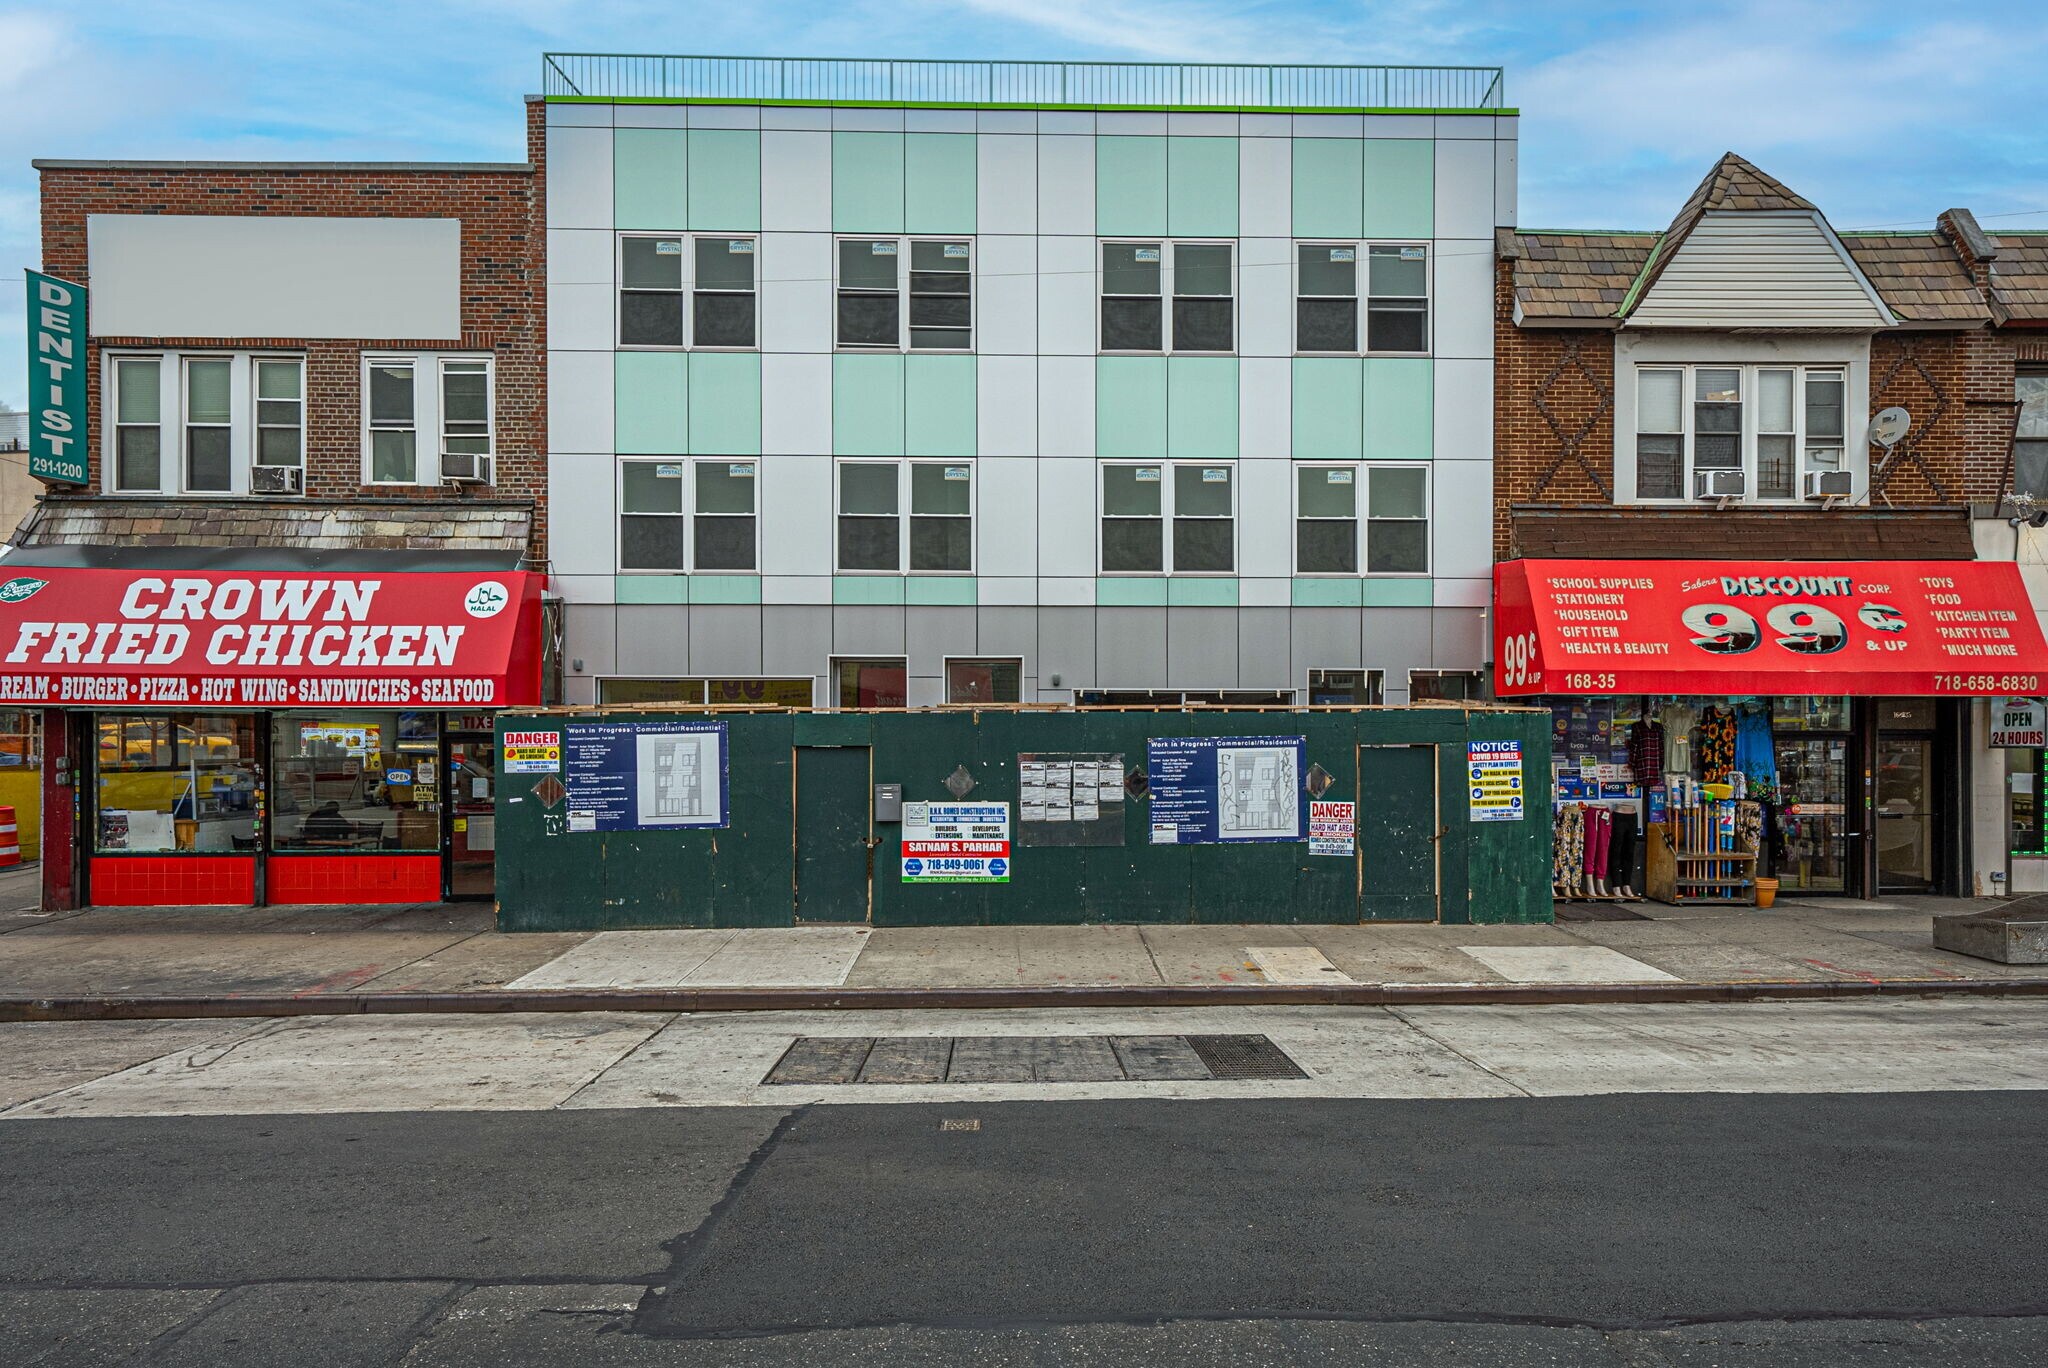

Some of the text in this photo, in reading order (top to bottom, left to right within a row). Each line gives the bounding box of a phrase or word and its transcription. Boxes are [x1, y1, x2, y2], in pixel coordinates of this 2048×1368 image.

[38, 280, 73, 456] DENTIST
[33, 456, 82, 478] 291-1200
[1552, 578, 1654, 589] SCHOOL SUPPLIES
[1682, 576, 1892, 597] Sabera DISCOUNT CORP.
[1926, 578, 1954, 588] TOYS
[119, 578, 382, 621] CROWN
[1556, 594, 1624, 604] STATIONERY
[1930, 594, 1961, 605] FOOD
[1560, 610, 1628, 620] HOUSEHOLD
[1936, 611, 2017, 621] KITCHEN ITEM
[1563, 627, 1619, 638] GIFT ITEM
[1942, 628, 2010, 638] PARTY ITEM
[4, 622, 465, 666] FRIED CHICKEN
[1566, 643, 1668, 654] HEALTH & BEAUTY
[1866, 640, 1908, 651] & UP
[1948, 645, 2018, 656] MUCH MORE
[1528, 672, 1541, 684] & UP
[1565, 674, 1616, 689] 168-35
[1934, 676, 2038, 690] 718-658-6830
[61, 677, 128, 701] BURGER
[139, 678, 189, 701] PIZZA
[201, 678, 235, 701] HOT
[241, 678, 288, 702] WING
[299, 679, 410, 702] SANDWICHES
[421, 679, 494, 702] SEAFOOD
[2004, 713, 2032, 727] OPEN
[506, 733, 557, 743] DANGER
[1993, 732, 2043, 745] 24 HOURS
[1472, 742, 1518, 752] NOTICE
[1312, 803, 1352, 818] DANGER
[909, 842, 1002, 852] SATNAM S. PARHAR
[927, 860, 984, 869] 718-849-0061
